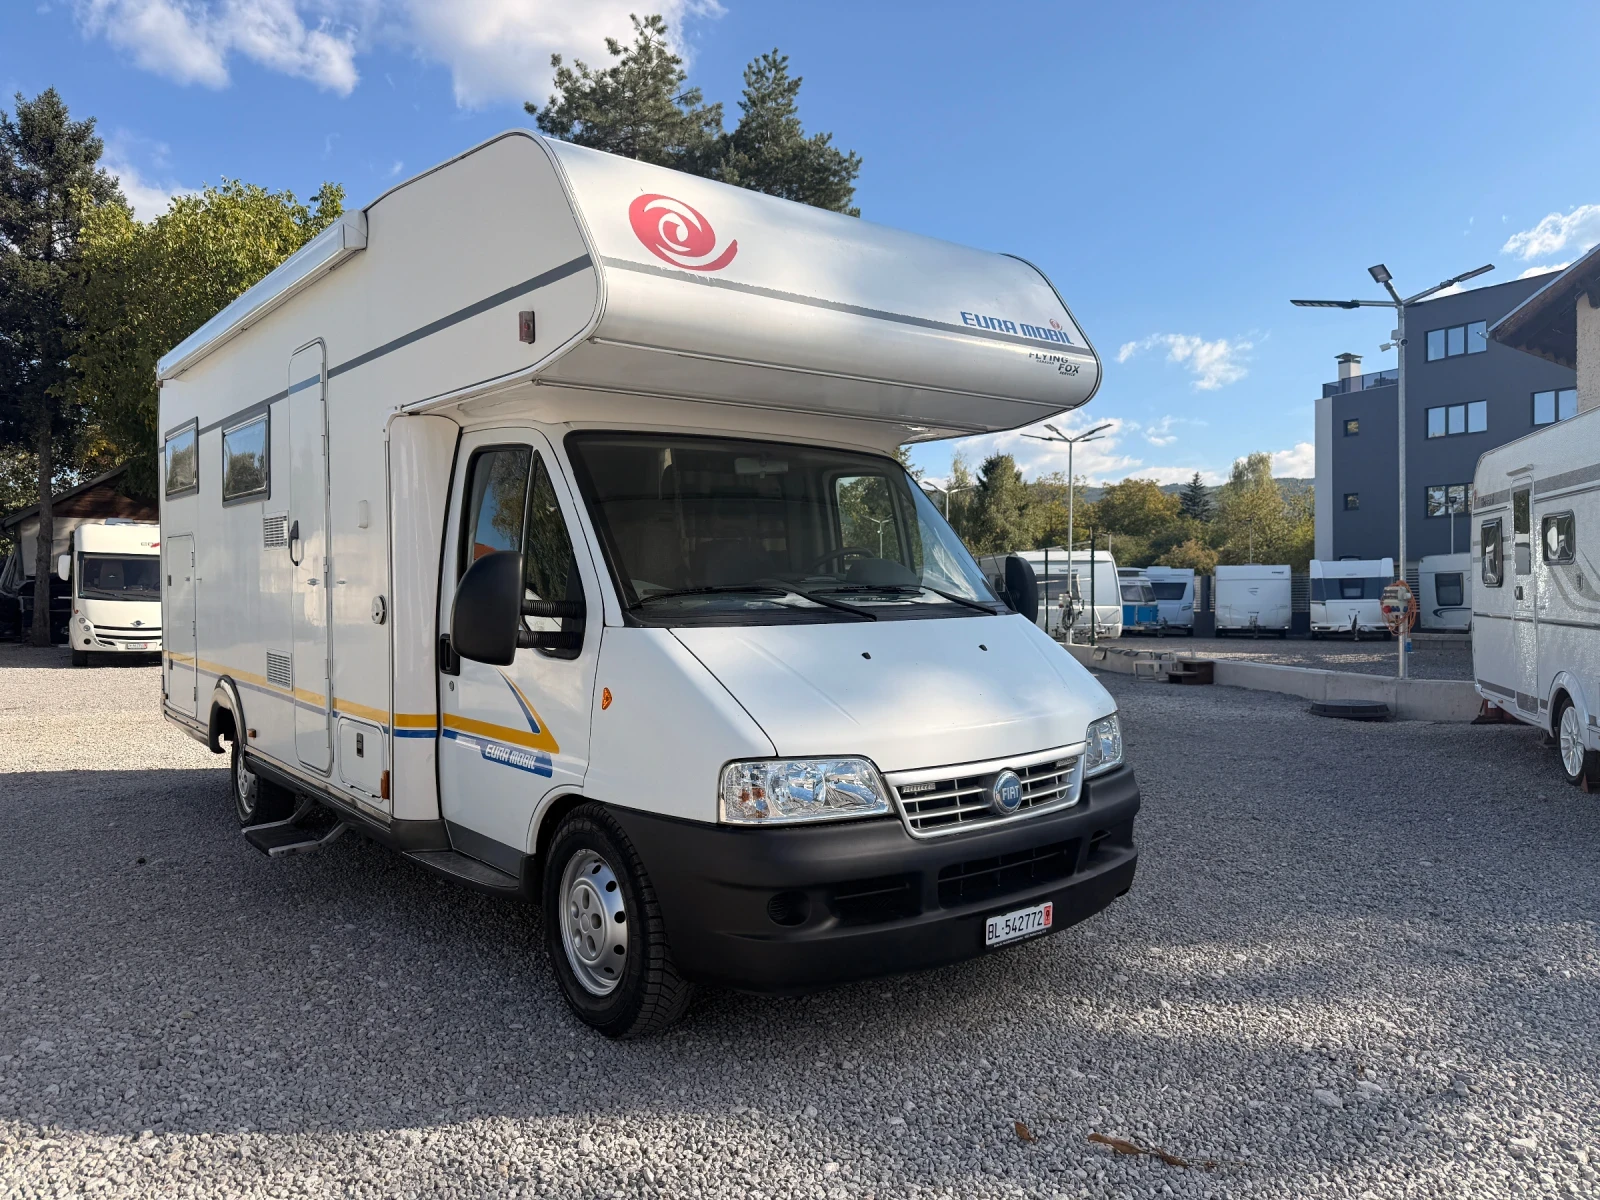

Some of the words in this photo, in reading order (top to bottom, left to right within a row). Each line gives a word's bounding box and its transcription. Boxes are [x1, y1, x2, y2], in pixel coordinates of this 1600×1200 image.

[960, 311, 1018, 335] EURA
[1020, 323, 1075, 345] MOBIL
[1028, 352, 1069, 364] FLYING
[1058, 363, 1080, 374] FOX
[485, 744, 510, 762] EURA
[510, 751, 537, 770] MOBIL
[1001, 784, 1020, 801] FIAT
